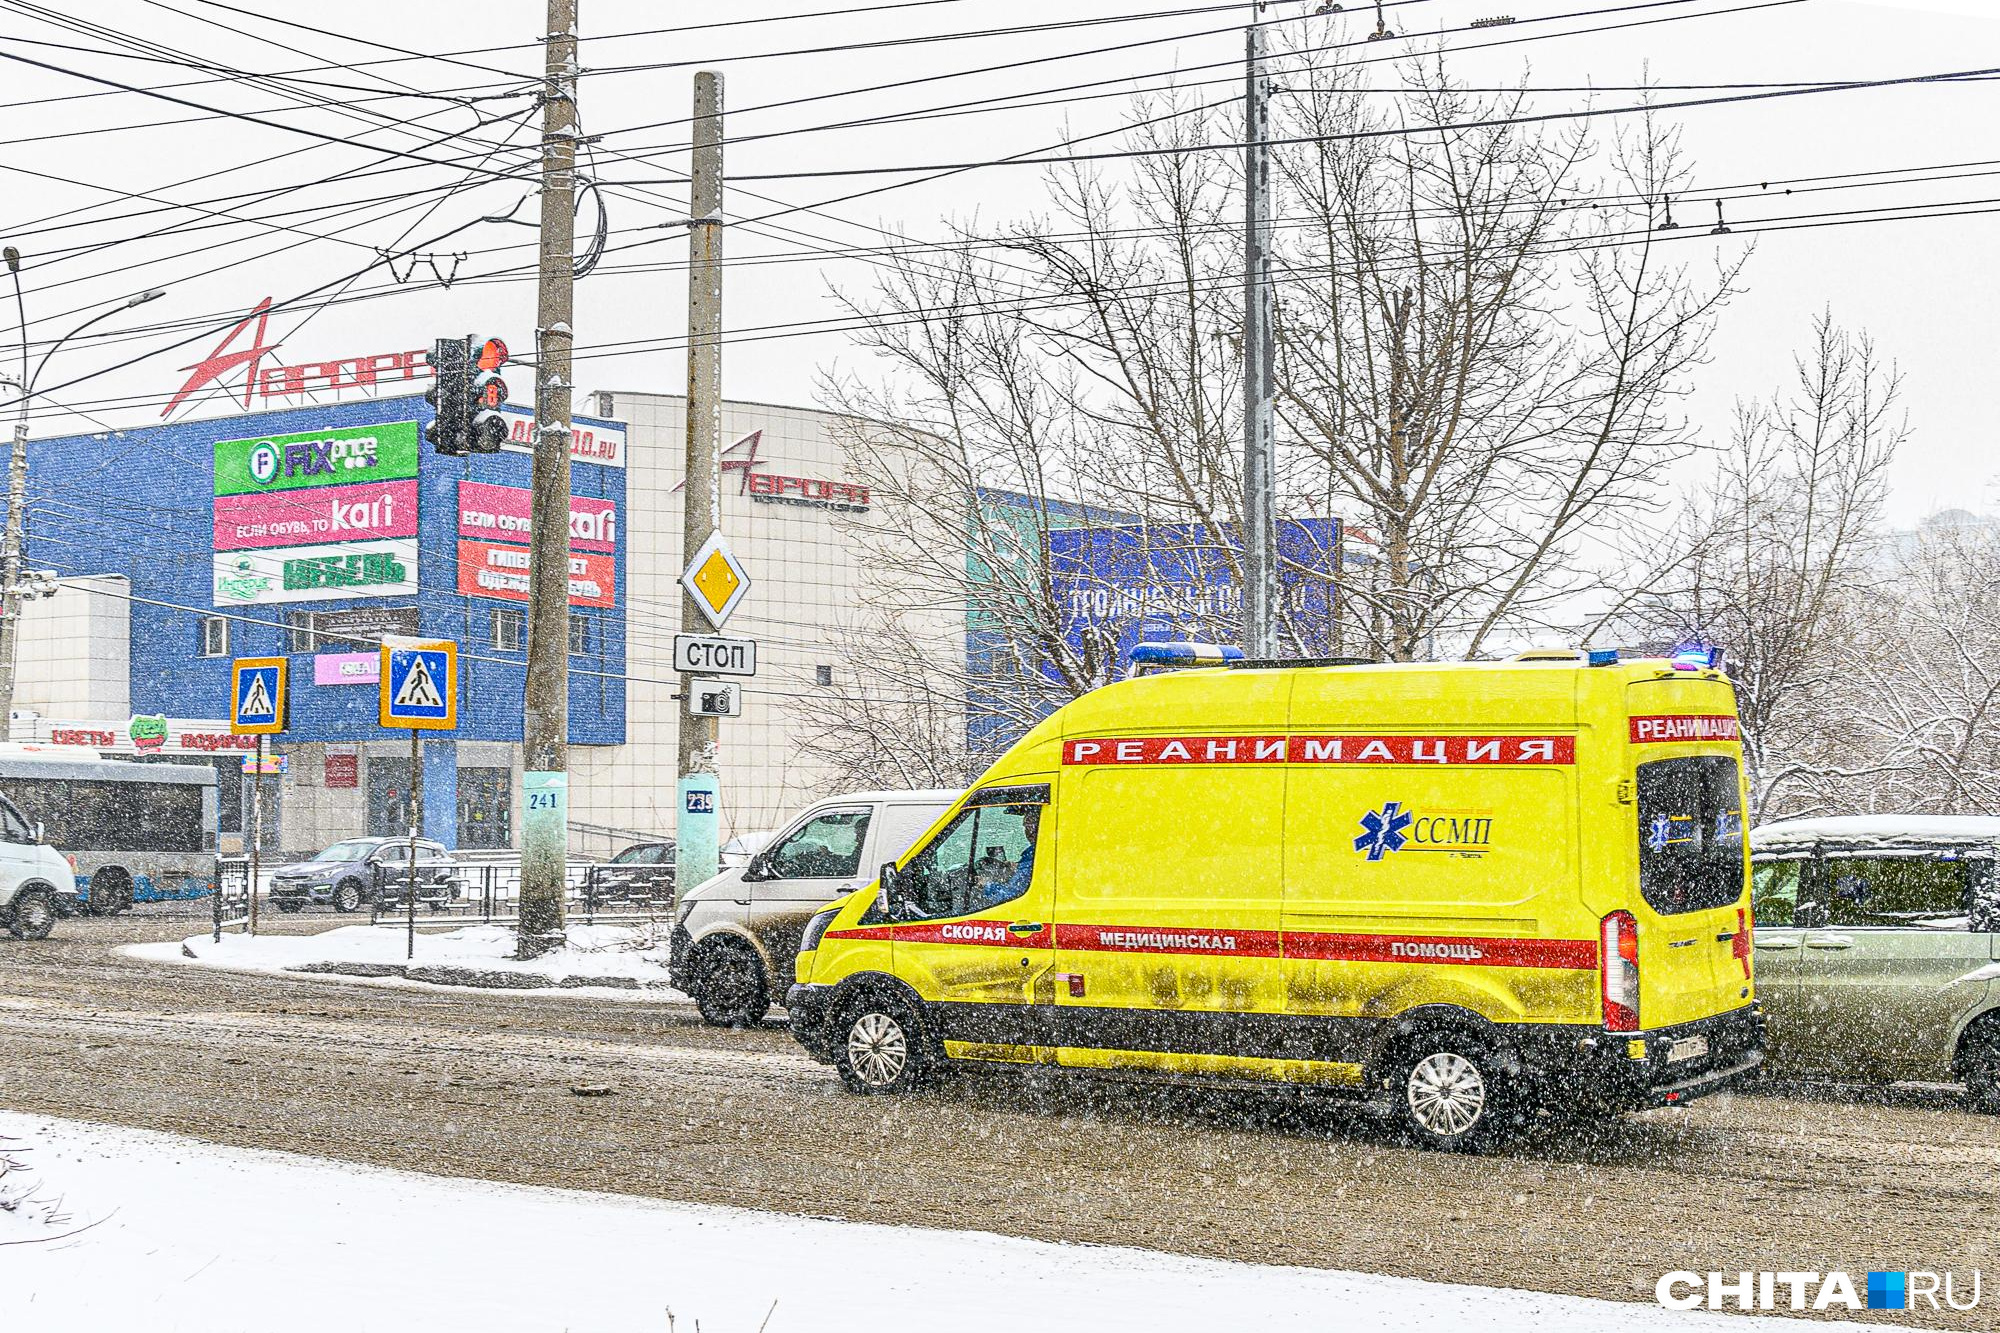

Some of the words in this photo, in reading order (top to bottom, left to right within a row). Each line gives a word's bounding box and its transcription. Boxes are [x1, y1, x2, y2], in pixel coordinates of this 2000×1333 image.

[236, 523, 267, 538] ЕСЛИ
[313, 519, 329, 532] ТО
[332, 494, 393, 531] kari
[462, 510, 496, 528] ЕСЛИ
[498, 515, 532, 532] ОБУВ
[687, 643, 744, 669] СТОП
[52, 729, 115, 746] ЦВЕТЫ
[1073, 740, 1555, 765] РЕАНИМАЦИЯ
[530, 793, 557, 810] 241
[1414, 817, 1494, 845] ССМП
[942, 924, 1006, 941] СКОРАЯ
[1100, 931, 1236, 950] МЕДИЦИНСКАЯ
[1392, 942, 1483, 960] ПОМОЩЬ
